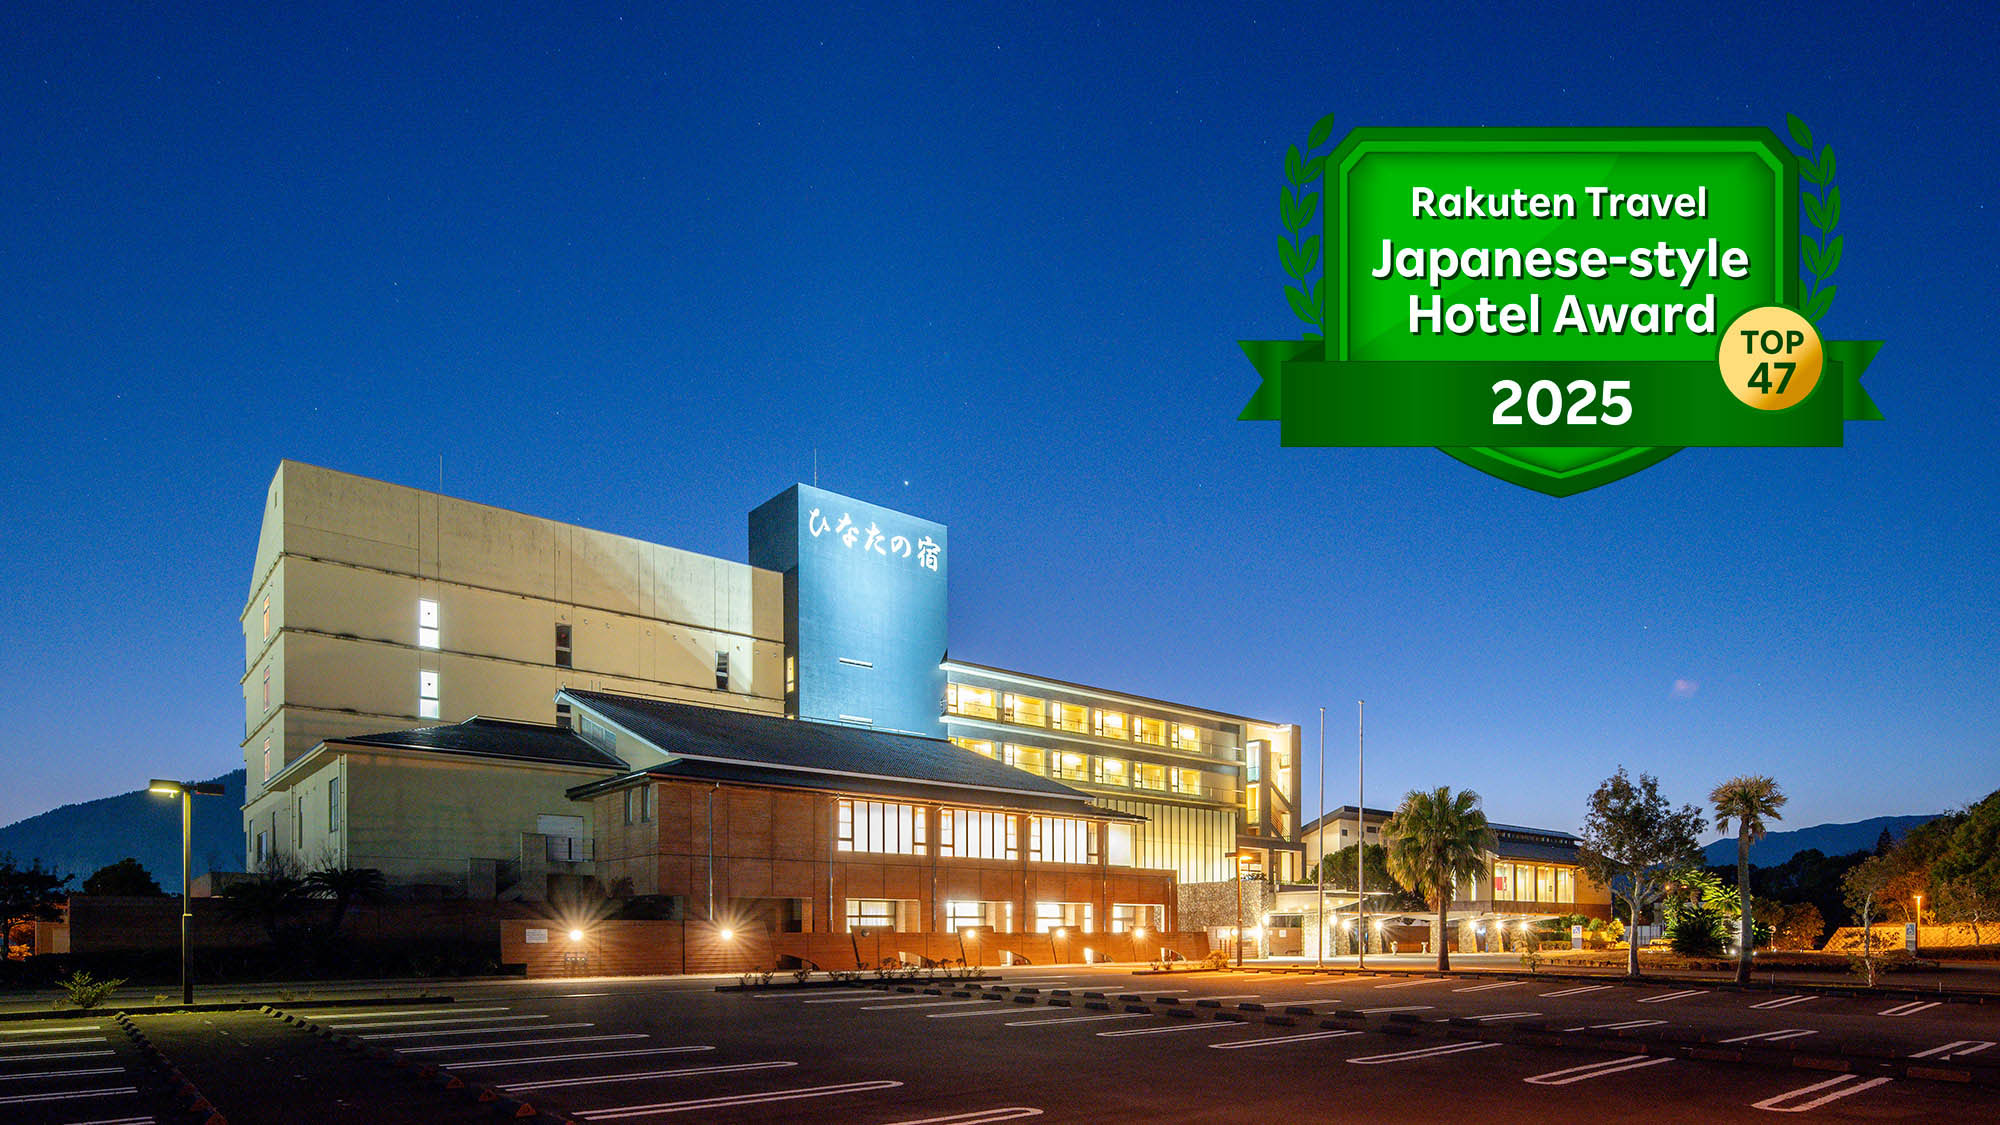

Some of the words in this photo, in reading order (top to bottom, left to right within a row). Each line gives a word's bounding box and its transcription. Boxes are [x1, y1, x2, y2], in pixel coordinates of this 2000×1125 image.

[808, 508, 942, 572] ひなたの宿
